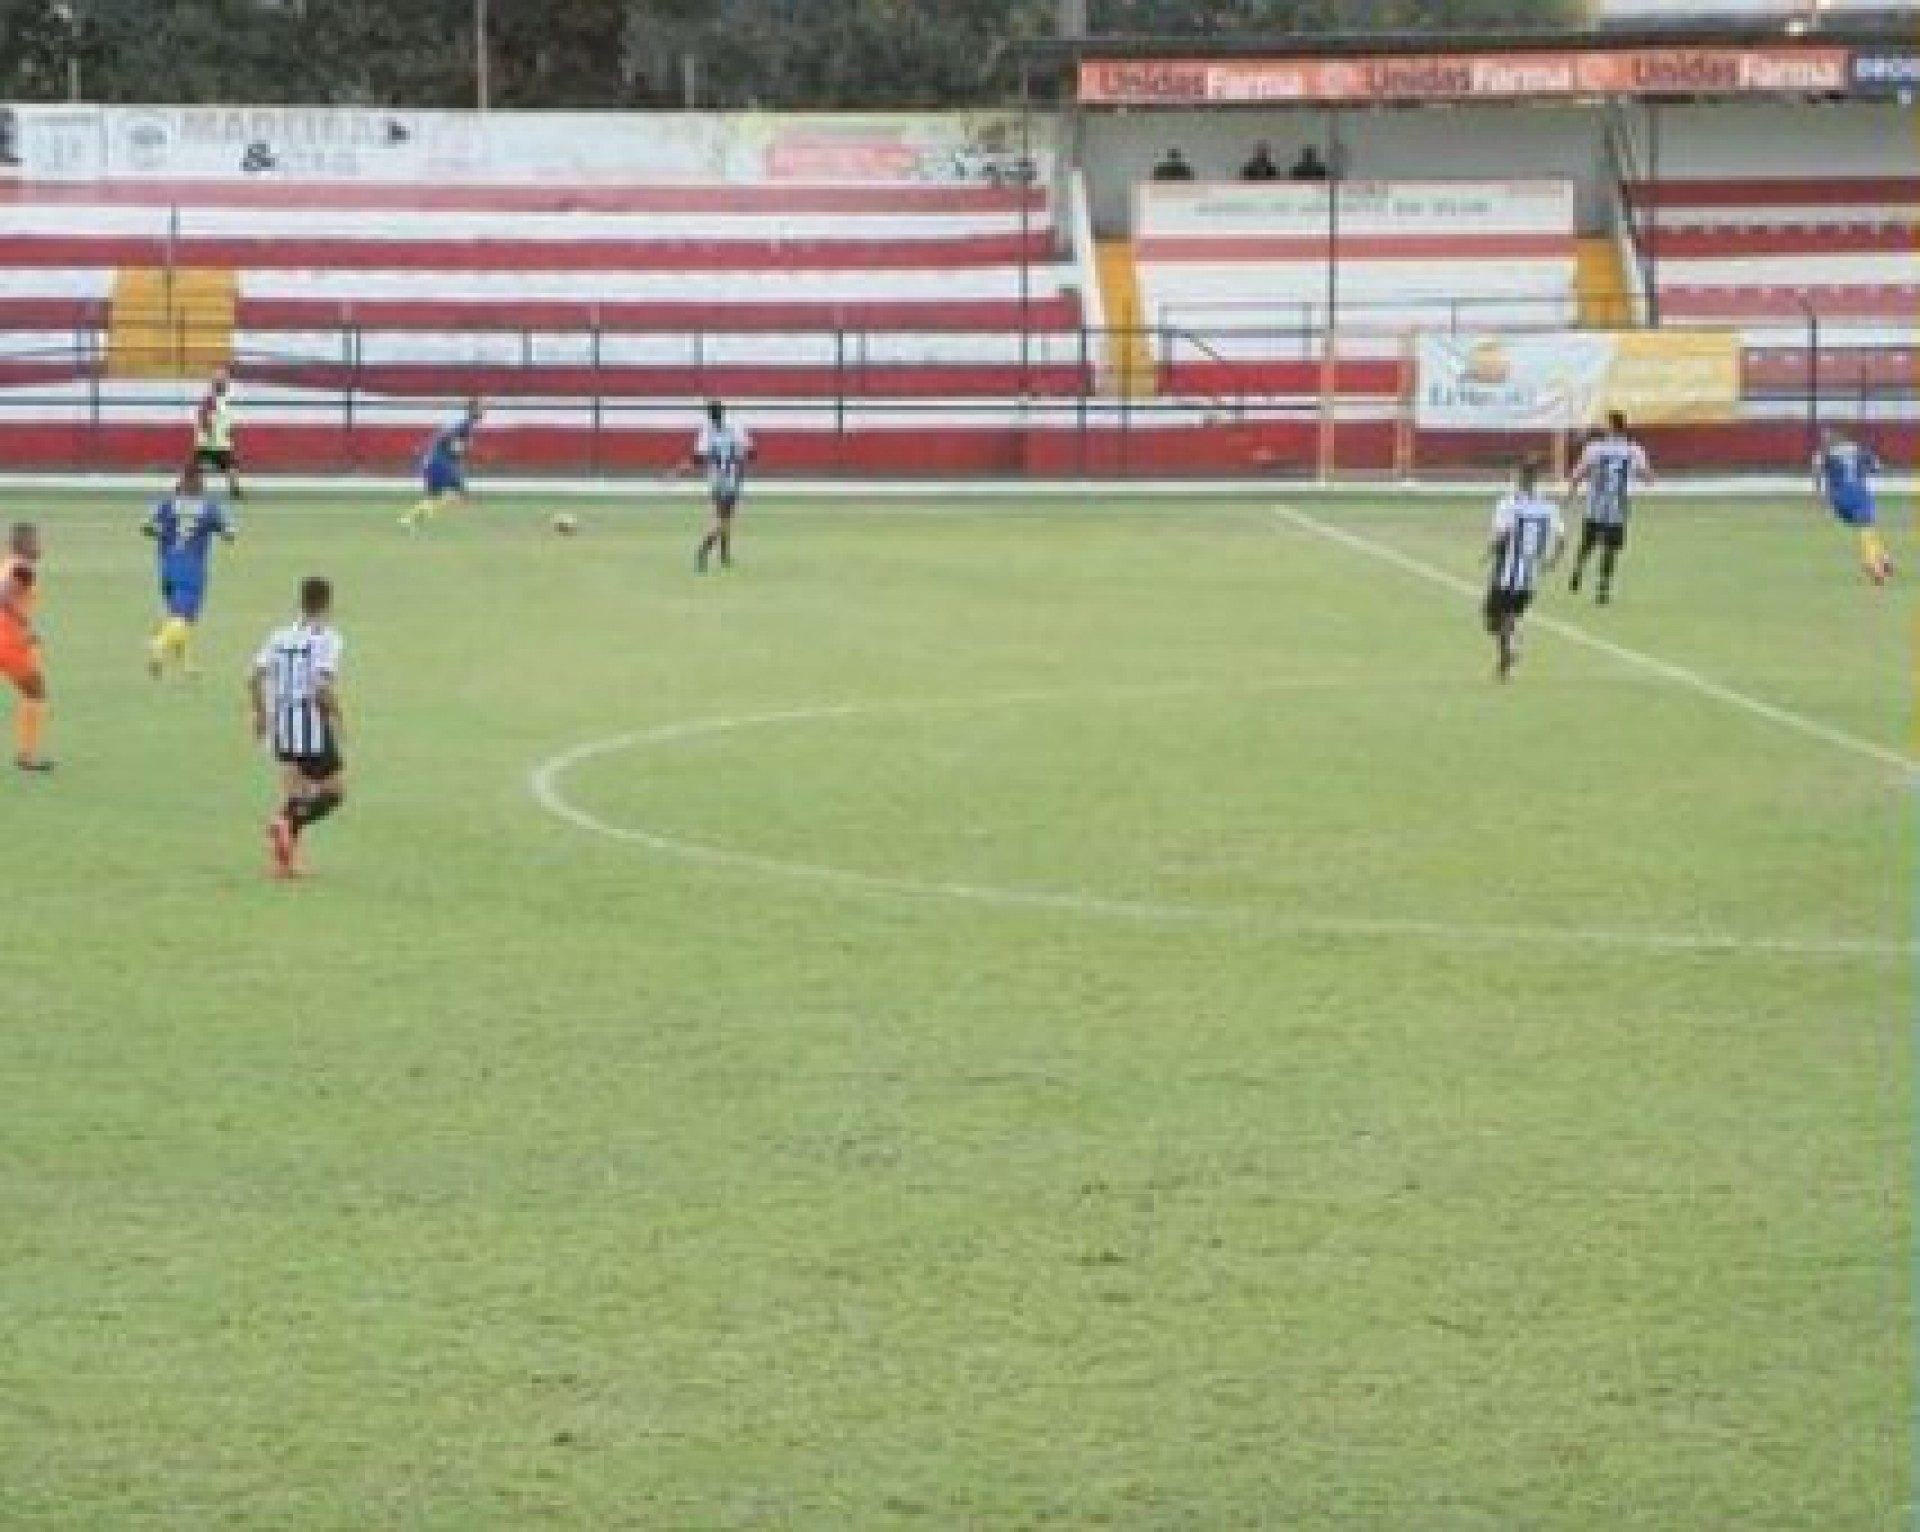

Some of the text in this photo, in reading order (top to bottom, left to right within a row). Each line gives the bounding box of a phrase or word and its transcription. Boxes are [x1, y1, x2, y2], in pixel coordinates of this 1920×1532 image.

[1098, 62, 1204, 97] Unidas
[1369, 58, 1470, 94] Unidas
[1631, 52, 1844, 88] Unidas Farma
